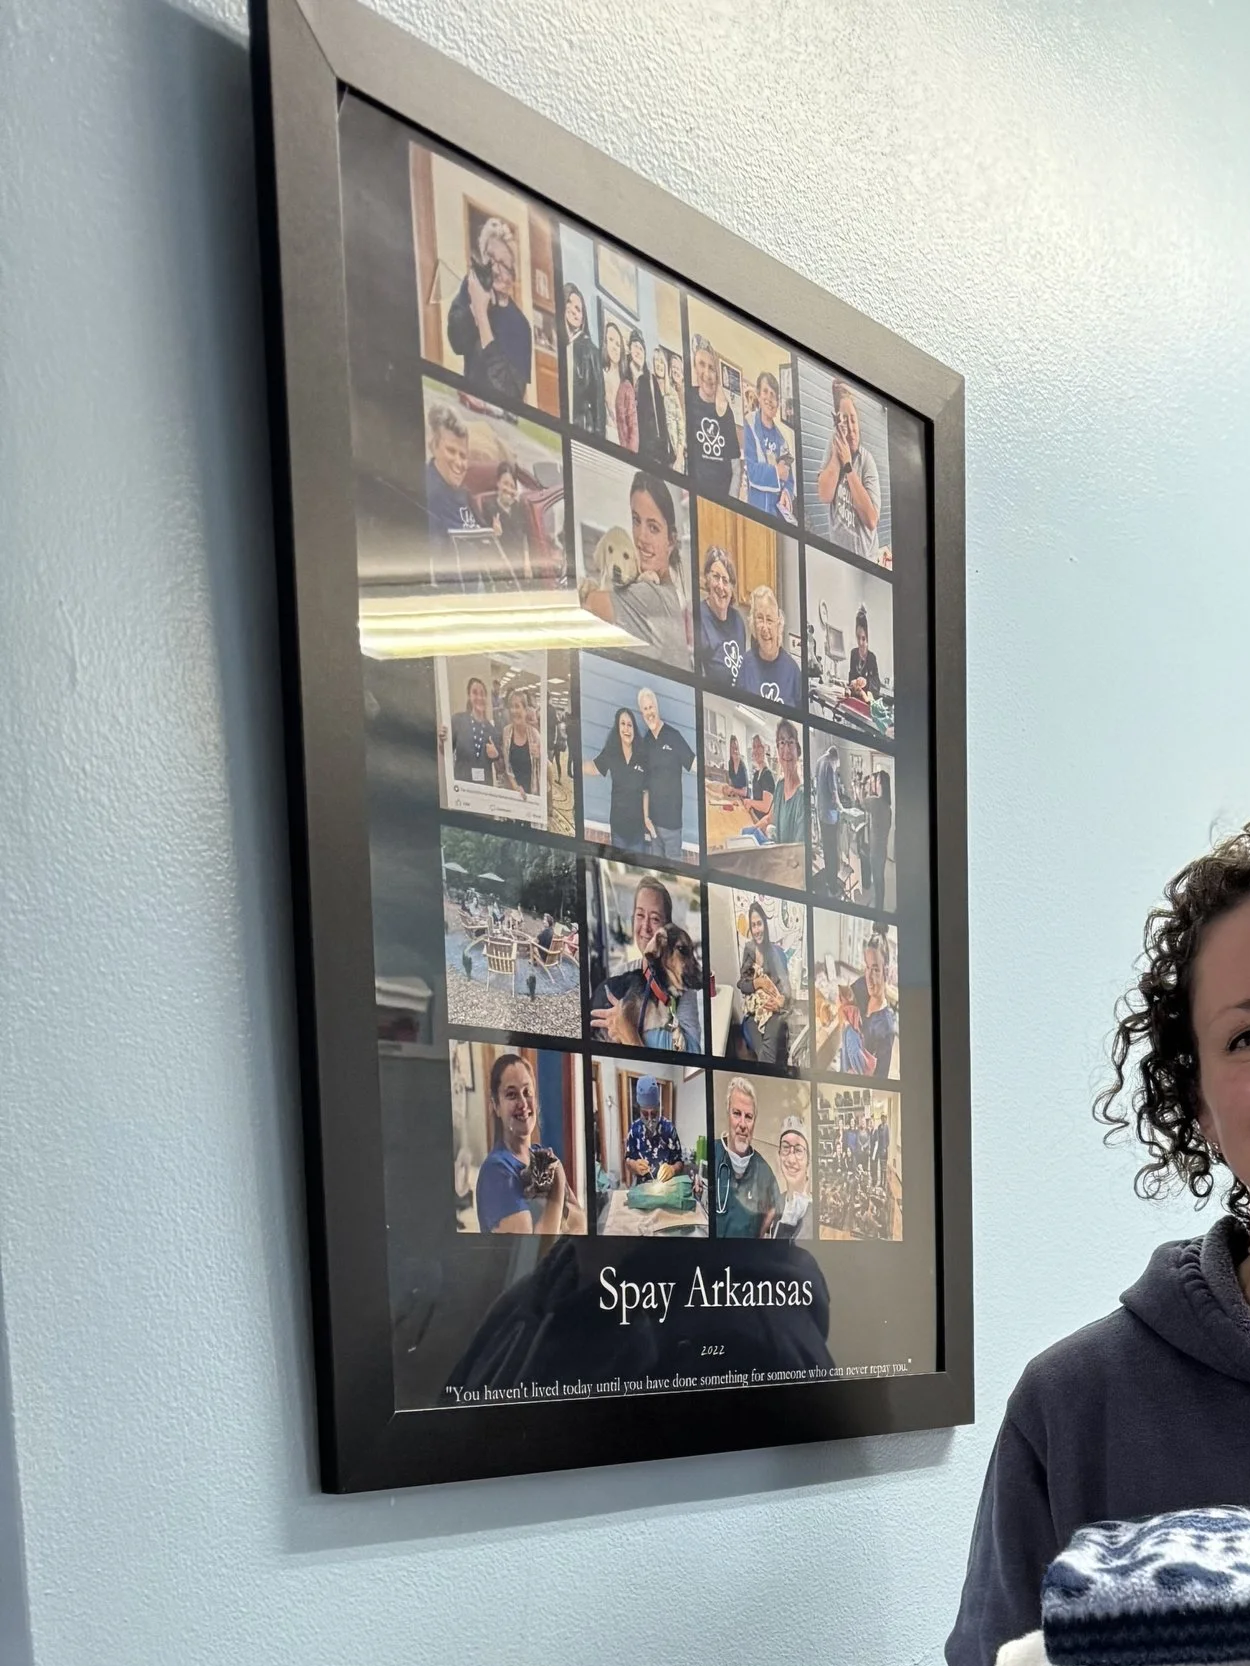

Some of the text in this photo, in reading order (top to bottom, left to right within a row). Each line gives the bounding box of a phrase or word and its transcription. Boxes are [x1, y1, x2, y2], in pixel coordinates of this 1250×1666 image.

[599, 1266, 813, 1325] Spay Arkansas
[700, 1345, 726, 1356] 2022
[445, 1358, 913, 1402] "You haven't lived today until you have done something for someone who can never repay you."
